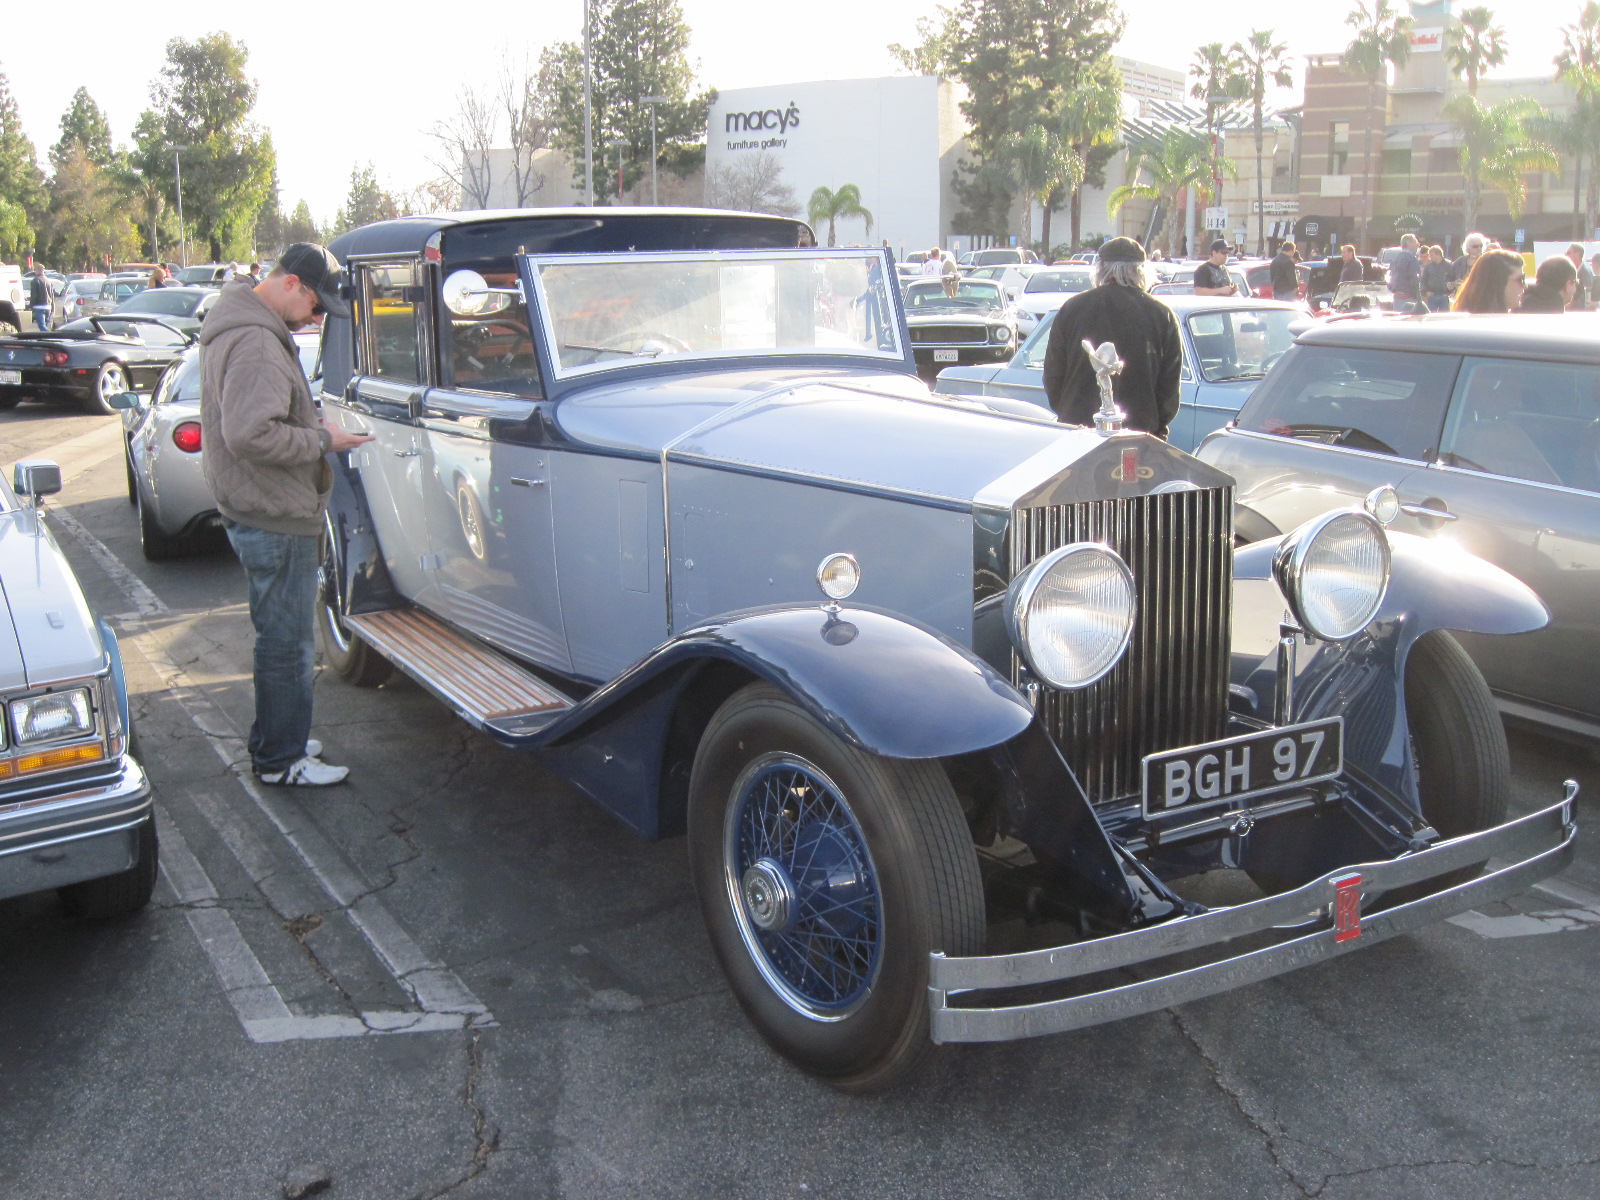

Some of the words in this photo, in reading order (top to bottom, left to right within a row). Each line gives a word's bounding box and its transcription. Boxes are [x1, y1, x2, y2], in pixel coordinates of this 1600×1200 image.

[727, 140, 759, 150] furniture
[761, 138, 788, 149] gallery
[1215, 217, 1227, 228] 14
[1165, 746, 1250, 807] BGH
[1273, 731, 1325, 781] 97
